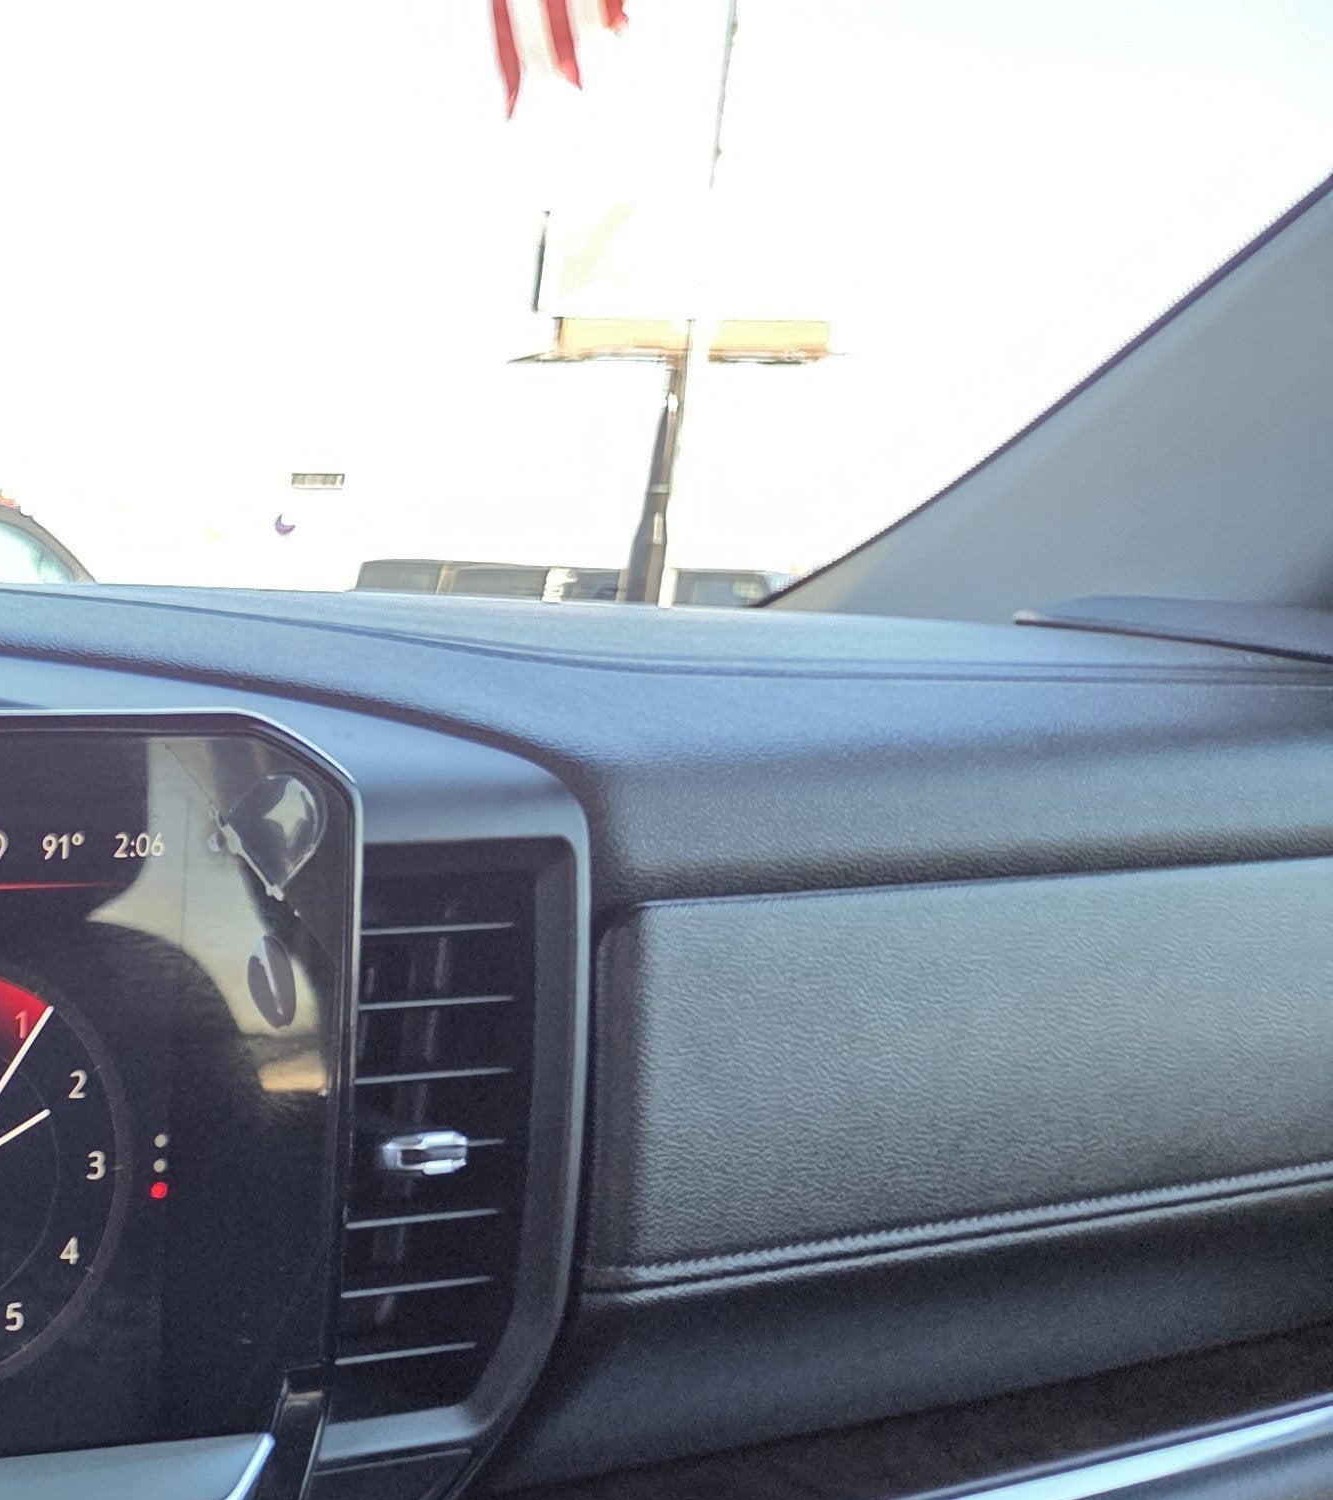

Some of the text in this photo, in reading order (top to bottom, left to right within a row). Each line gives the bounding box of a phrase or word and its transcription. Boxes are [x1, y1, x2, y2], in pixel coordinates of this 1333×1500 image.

[114, 832, 165, 858] 2:06
[15, 1010, 29, 1038] 1
[68, 1070, 88, 1099] 2
[86, 1151, 106, 1180] 3
[60, 1237, 80, 1265] 4
[5, 1303, 24, 1332] 5
